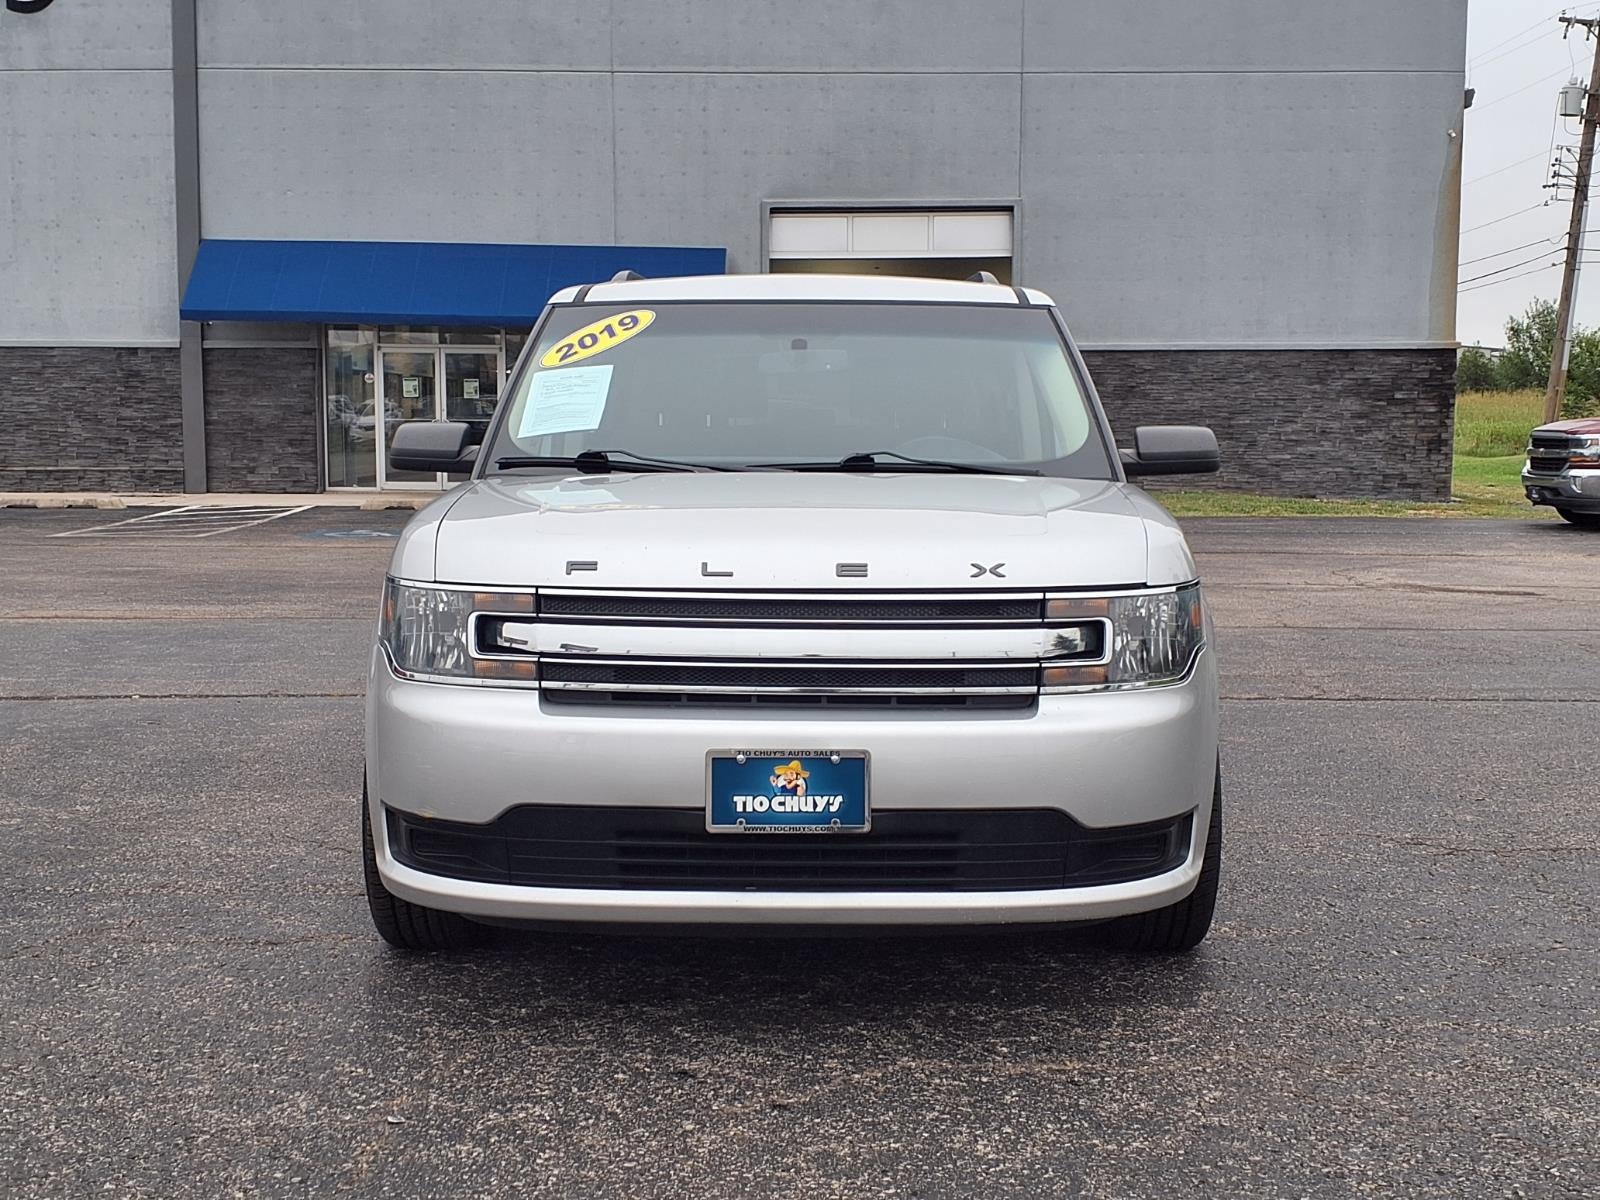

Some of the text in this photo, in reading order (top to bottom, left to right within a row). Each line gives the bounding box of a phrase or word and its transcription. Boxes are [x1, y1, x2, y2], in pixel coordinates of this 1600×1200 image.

[555, 314, 639, 363] 2019
[565, 560, 1007, 578] FLEX
[733, 795, 844, 812] TIO CHUY'S
